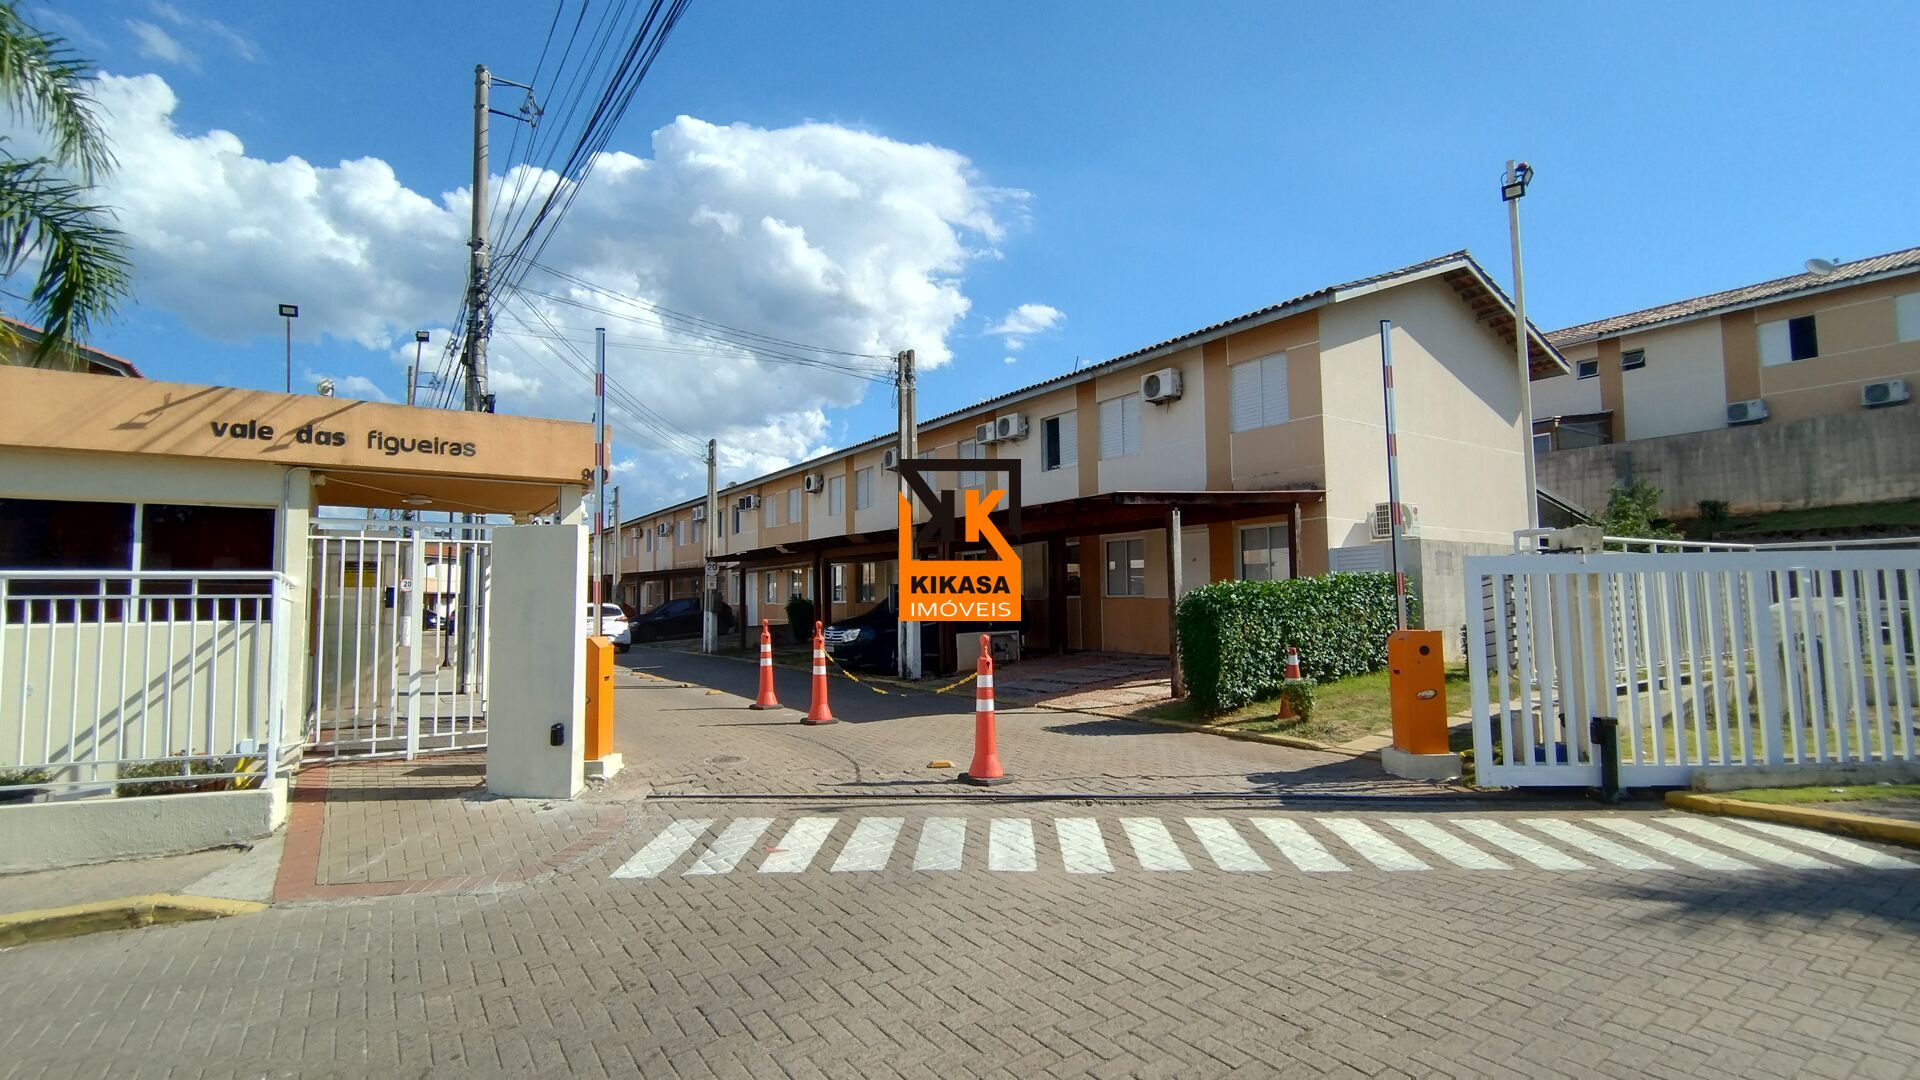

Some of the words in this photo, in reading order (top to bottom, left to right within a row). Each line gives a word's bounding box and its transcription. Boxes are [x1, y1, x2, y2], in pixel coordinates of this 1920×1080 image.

[211, 419, 274, 441] vale
[296, 425, 346, 447] das
[367, 430, 477, 457] figueiras
[706, 563, 718, 571] 20
[403, 580, 412, 588] 20
